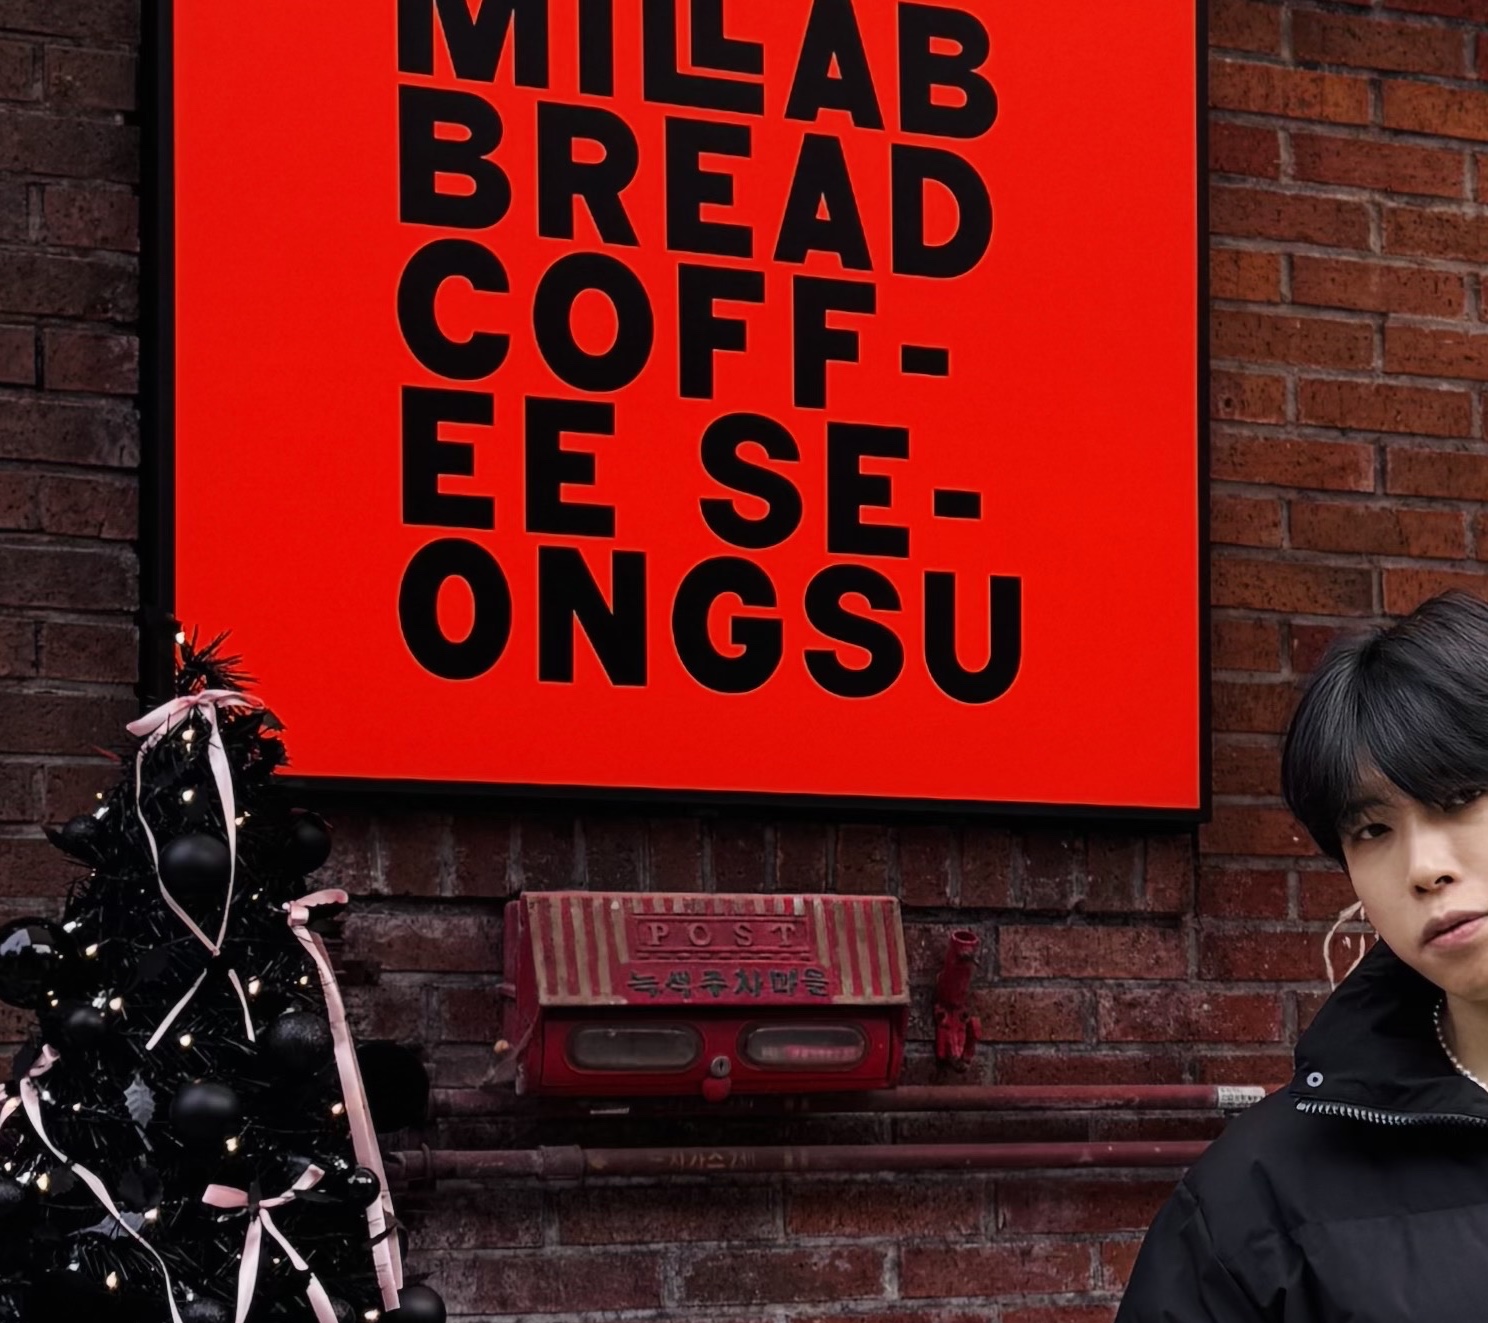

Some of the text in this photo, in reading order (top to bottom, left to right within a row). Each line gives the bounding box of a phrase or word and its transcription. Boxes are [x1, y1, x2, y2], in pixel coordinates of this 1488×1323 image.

[397, 0, 998, 139] MILLAB
[398, 84, 993, 279] BREAD
[397, 238, 949, 410] COFF-
[401, 385, 981, 559] EE SE-
[398, 537, 1022, 705] ONGSU
[649, 922, 797, 948] POST
